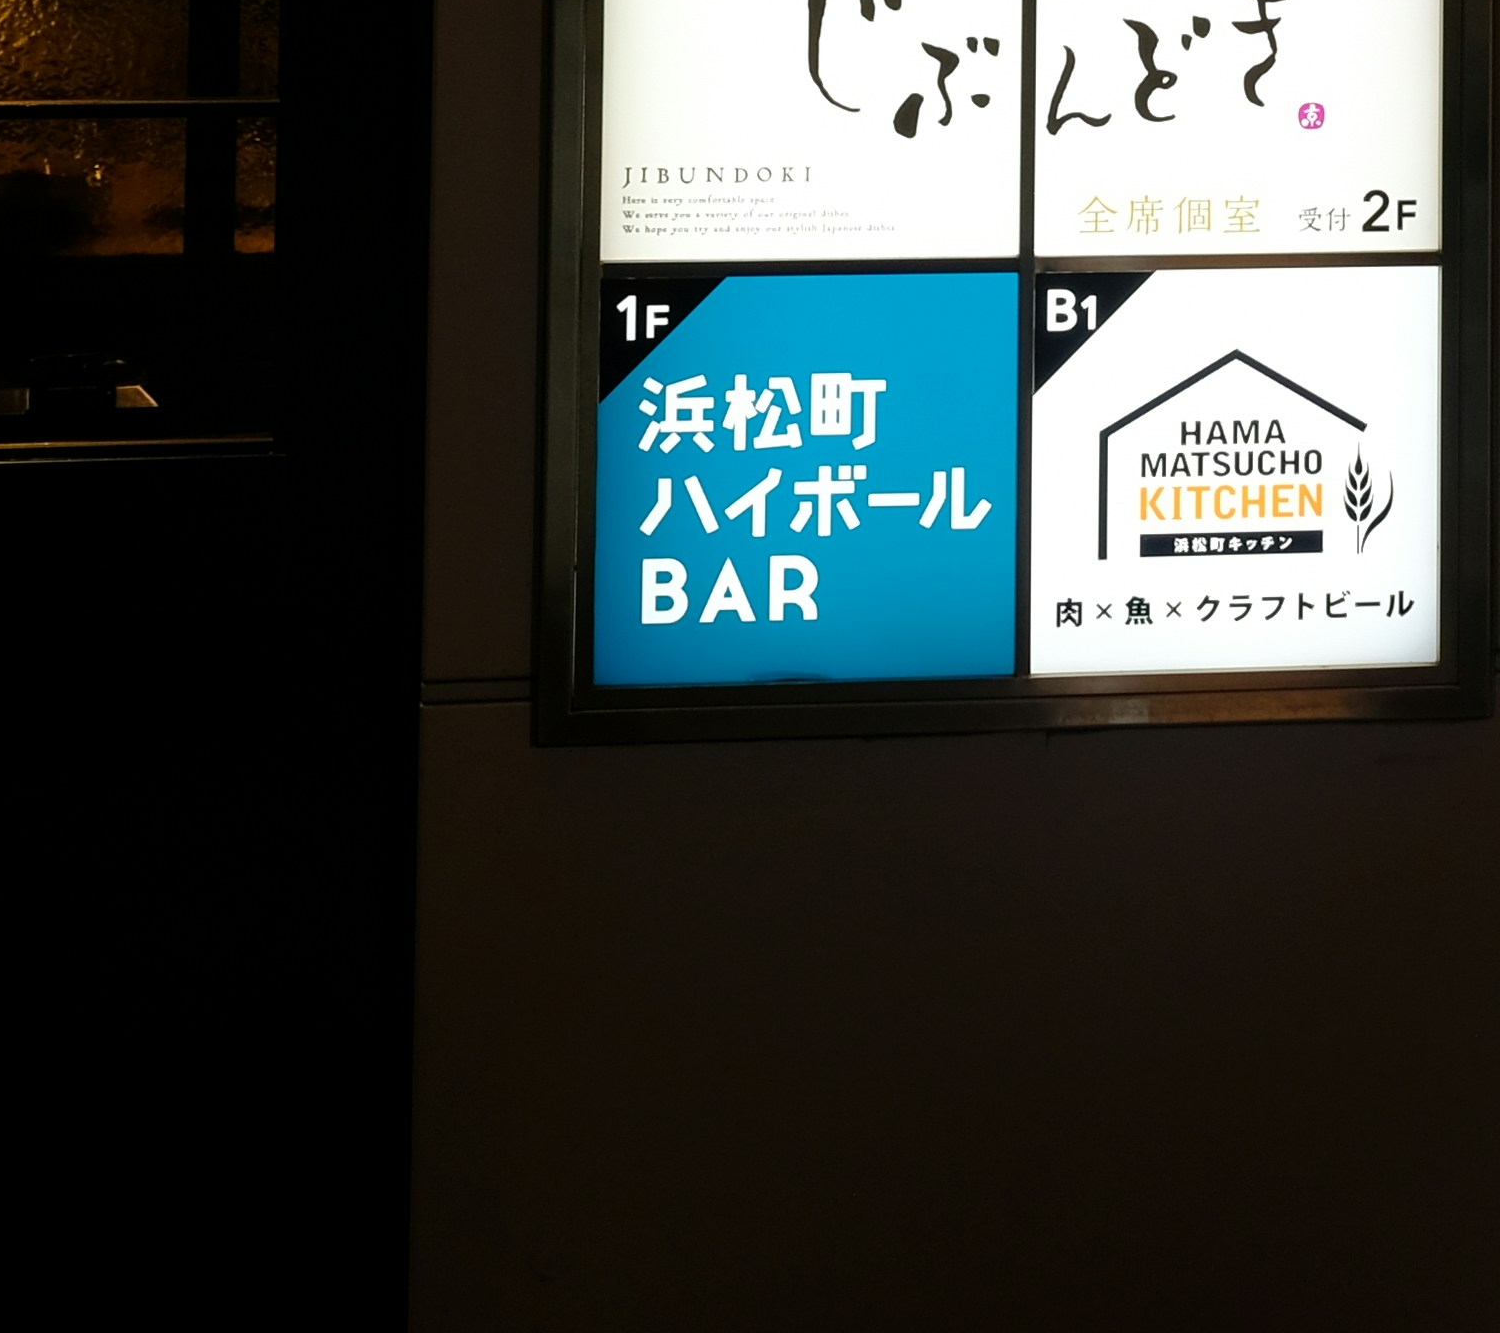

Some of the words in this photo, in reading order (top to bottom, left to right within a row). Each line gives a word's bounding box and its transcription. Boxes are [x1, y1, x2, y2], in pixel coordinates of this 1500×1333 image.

[621, 166, 812, 189] JIBUNDOKI
[622, 210, 640, 219] We
[622, 224, 640, 233] We
[1077, 195, 1263, 235] 全席個室
[1298, 206, 1352, 234] 受付
[1361, 189, 1418, 232] 2F
[616, 295, 670, 341] 1F
[1046, 289, 1098, 331] B1
[637, 372, 887, 453] 浜松町
[1180, 419, 1286, 446] HAMA
[1140, 449, 1323, 478] MATSUCHO
[639, 464, 992, 538] ハイボール
[1139, 483, 1323, 521] KITCHEN
[1173, 536, 1293, 553] 浜松町キッチン
[641, 555, 820, 625] BAR
